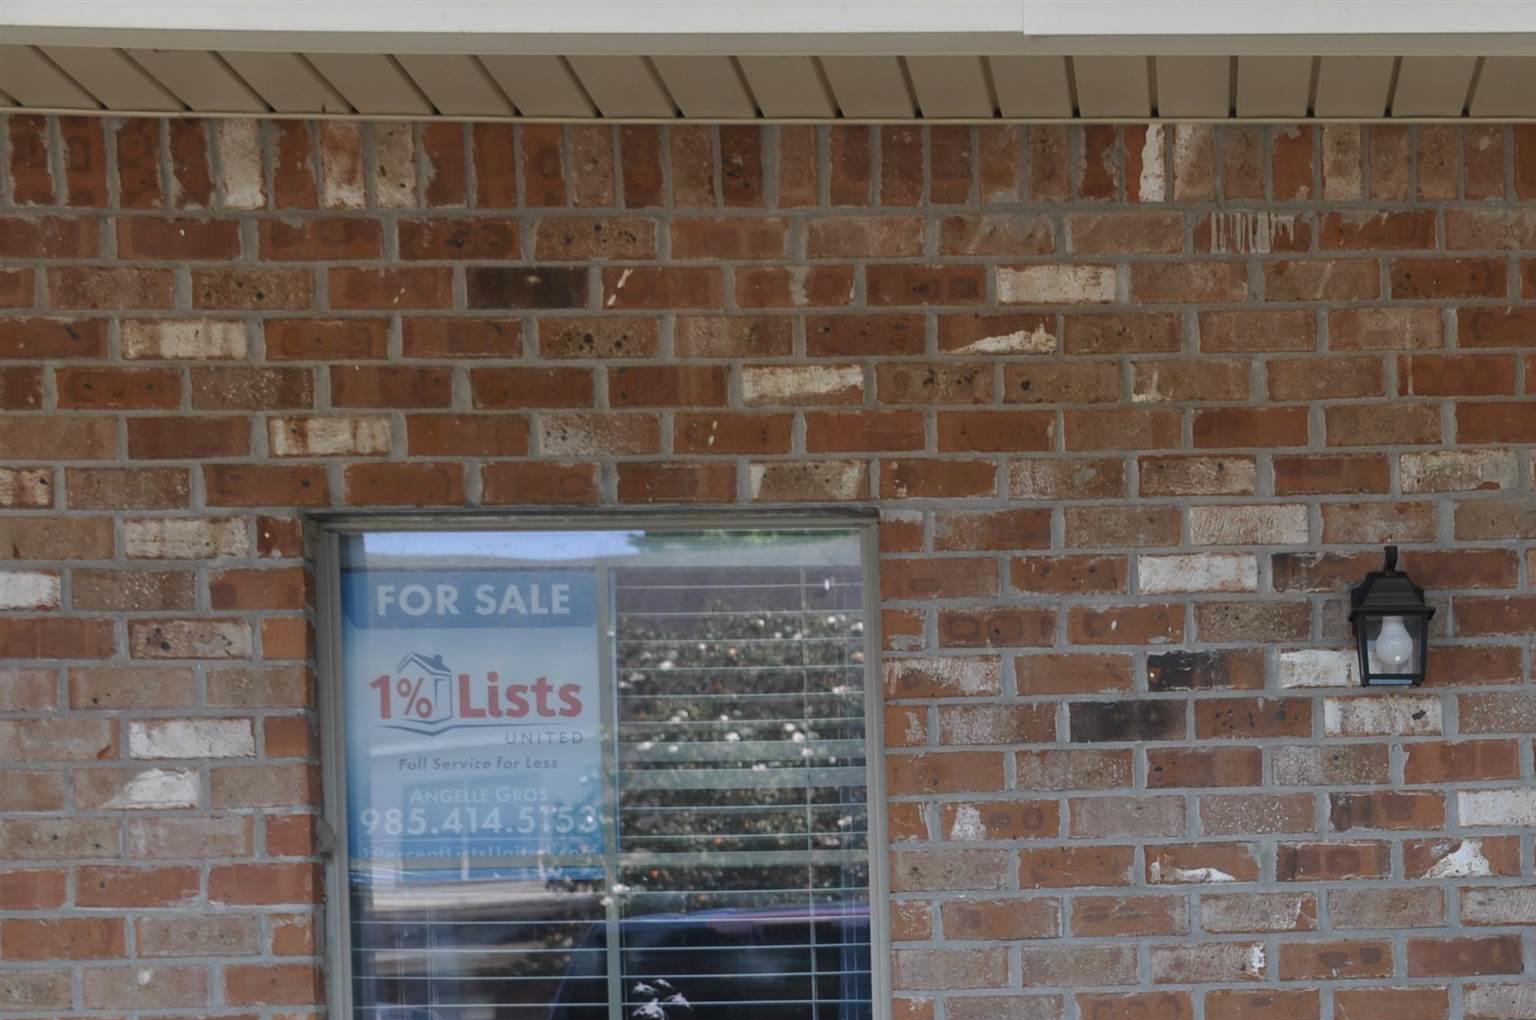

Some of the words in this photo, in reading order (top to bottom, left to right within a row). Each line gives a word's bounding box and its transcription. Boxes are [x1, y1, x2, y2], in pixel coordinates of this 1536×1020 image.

[377, 584, 461, 616] FOR
[475, 584, 571, 616] SALE
[370, 674, 433, 720] 1%
[458, 671, 584, 719] Lists
[505, 731, 584, 745] UNITED
[398, 757, 428, 771] Full
[432, 757, 491, 770] Service
[497, 756, 520, 770] for
[525, 757, 559, 770] Less
[361, 805, 598, 836] 985.414.5153
